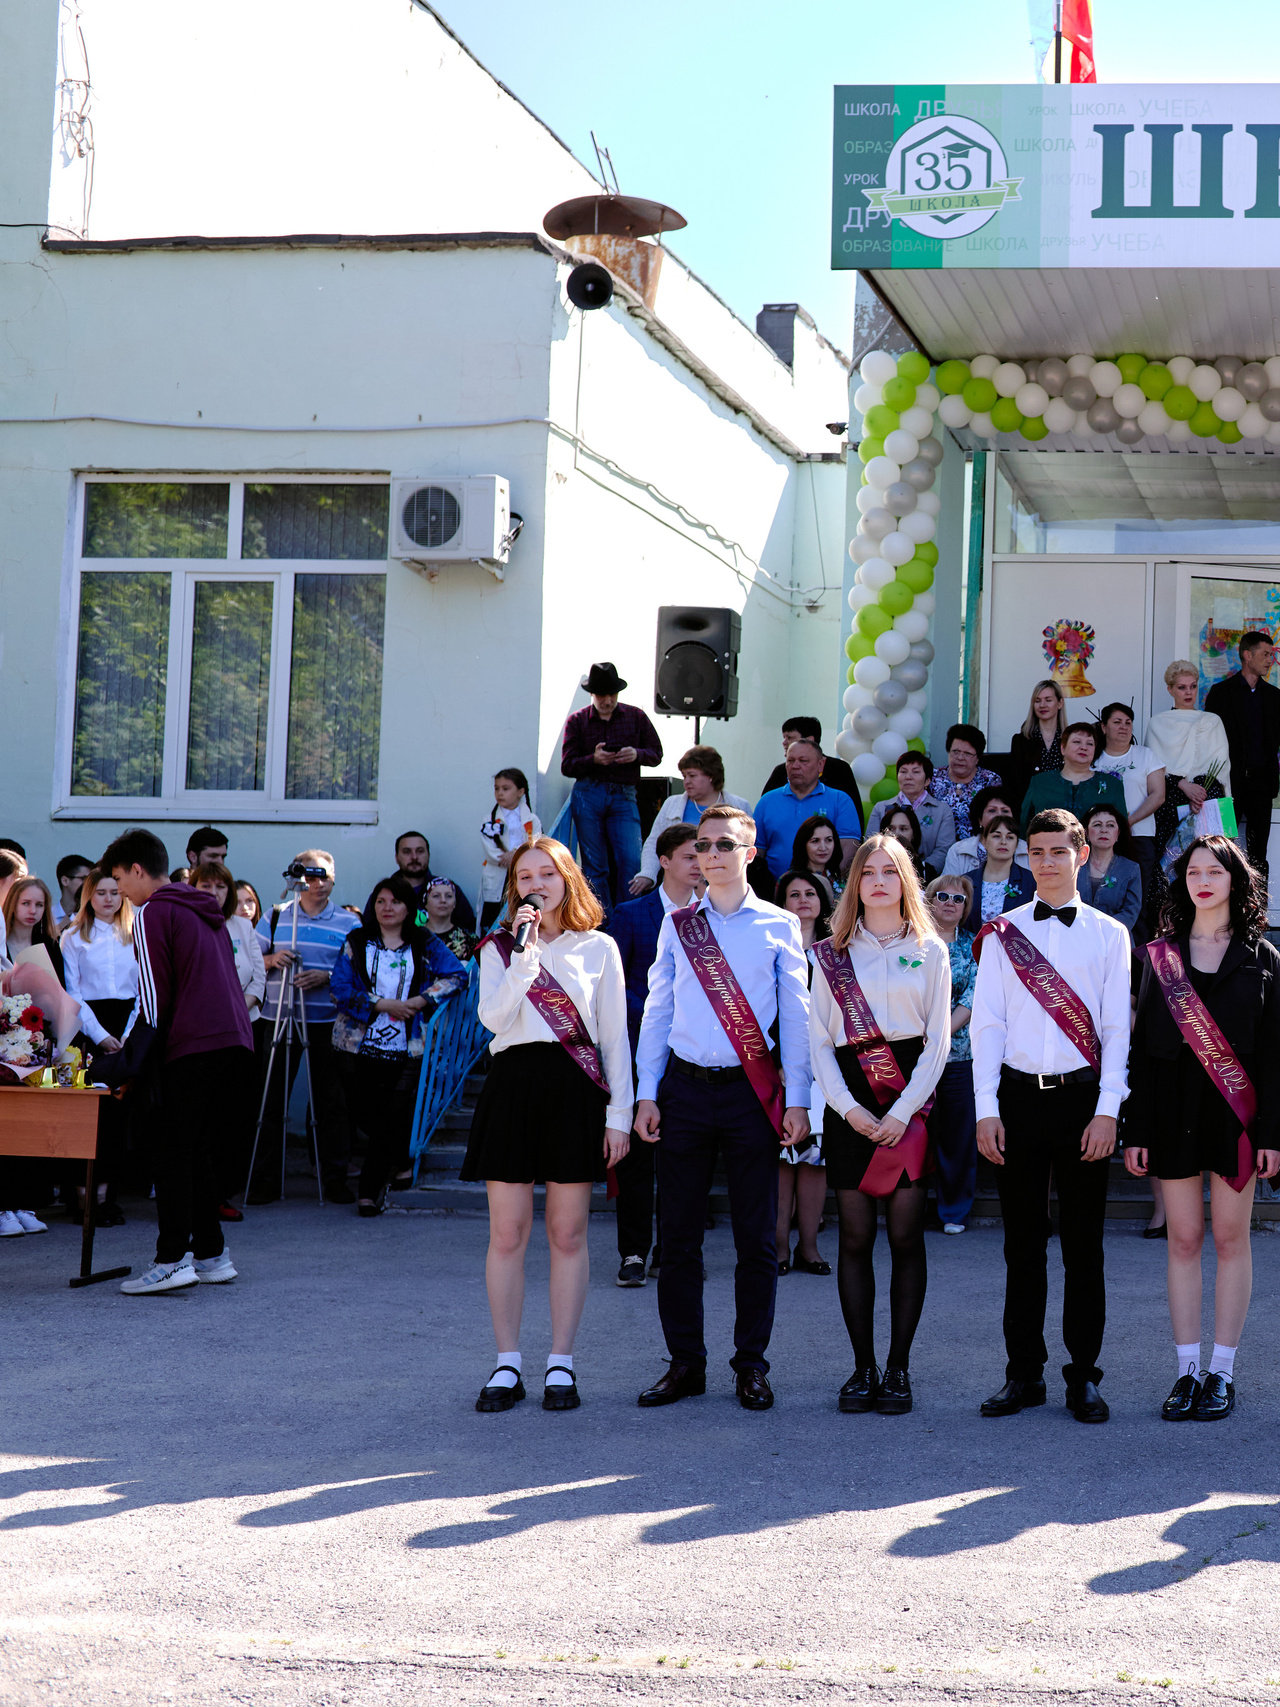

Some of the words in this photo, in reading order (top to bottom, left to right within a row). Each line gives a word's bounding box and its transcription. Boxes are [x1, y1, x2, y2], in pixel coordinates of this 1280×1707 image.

[844, 102, 901, 117] ШКОЛА
[1028, 105, 1058, 116] УРОК
[1069, 103, 1127, 116] ШКОЛА
[1138, 99, 1213, 118] УЧЕБА
[1014, 138, 1077, 153] ШКОЛА
[914, 149, 973, 192] 35
[843, 174, 880, 186] УРОК
[908, 194, 982, 212] ШКОЛА
[842, 238, 954, 254] ОБРАЗОВАНИЕ
[965, 236, 1029, 252] ШКОЛА
[1040, 236, 1086, 248] ДРУЗЬЯ
[1090, 232, 1166, 252] УЧЕБА
[698, 945, 743, 1024] Выпускник
[735, 1022, 766, 1060] 2022
[1029, 962, 1090, 1037] Выпускник
[1173, 983, 1222, 1060] Выпускница
[1213, 1055, 1248, 1093] 2022
[863, 1043, 896, 1080] 2022
